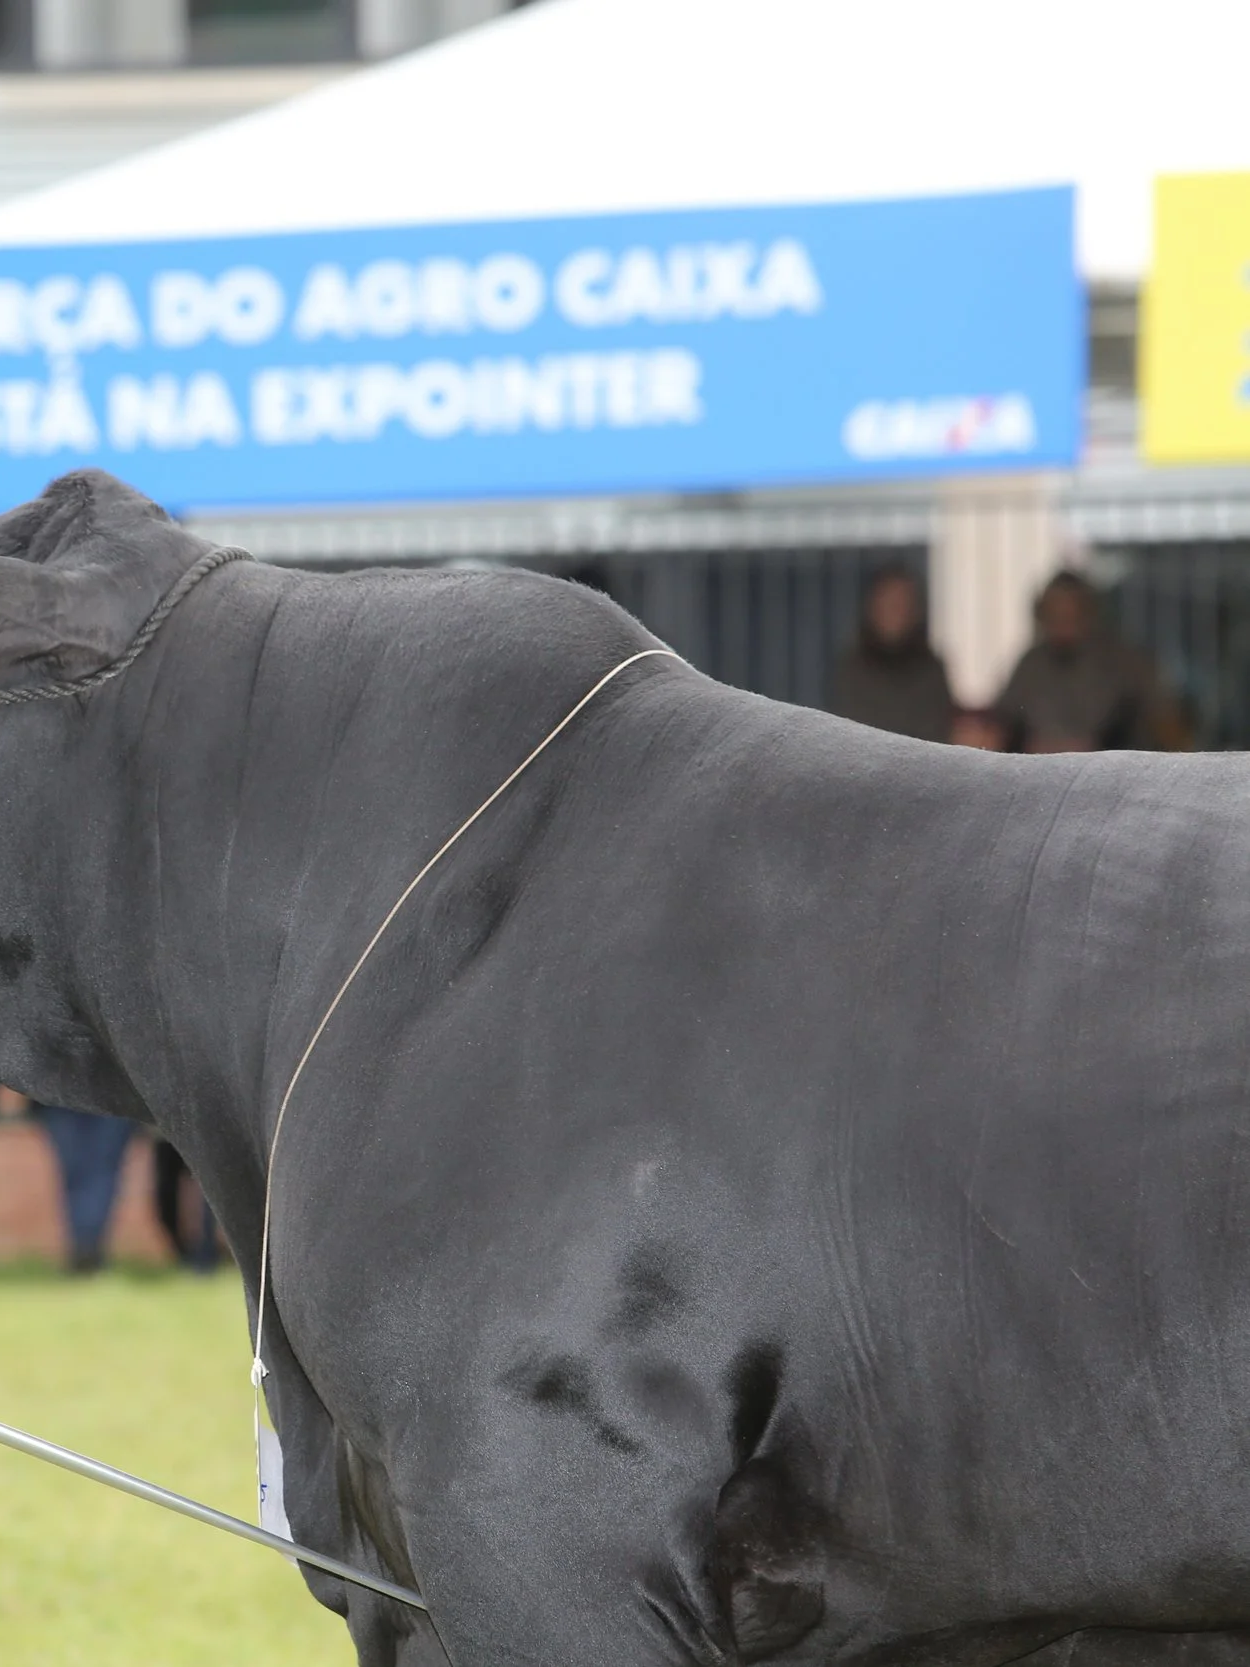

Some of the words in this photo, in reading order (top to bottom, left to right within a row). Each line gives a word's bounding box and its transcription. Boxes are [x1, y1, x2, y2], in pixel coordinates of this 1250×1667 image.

[152, 268, 283, 345] DO
[296, 252, 543, 339] AGRO
[555, 240, 820, 327] CAIXA
[109, 374, 240, 449] NA
[252, 347, 701, 445] EXPOINTER
[843, 391, 1036, 458] CAIXA
